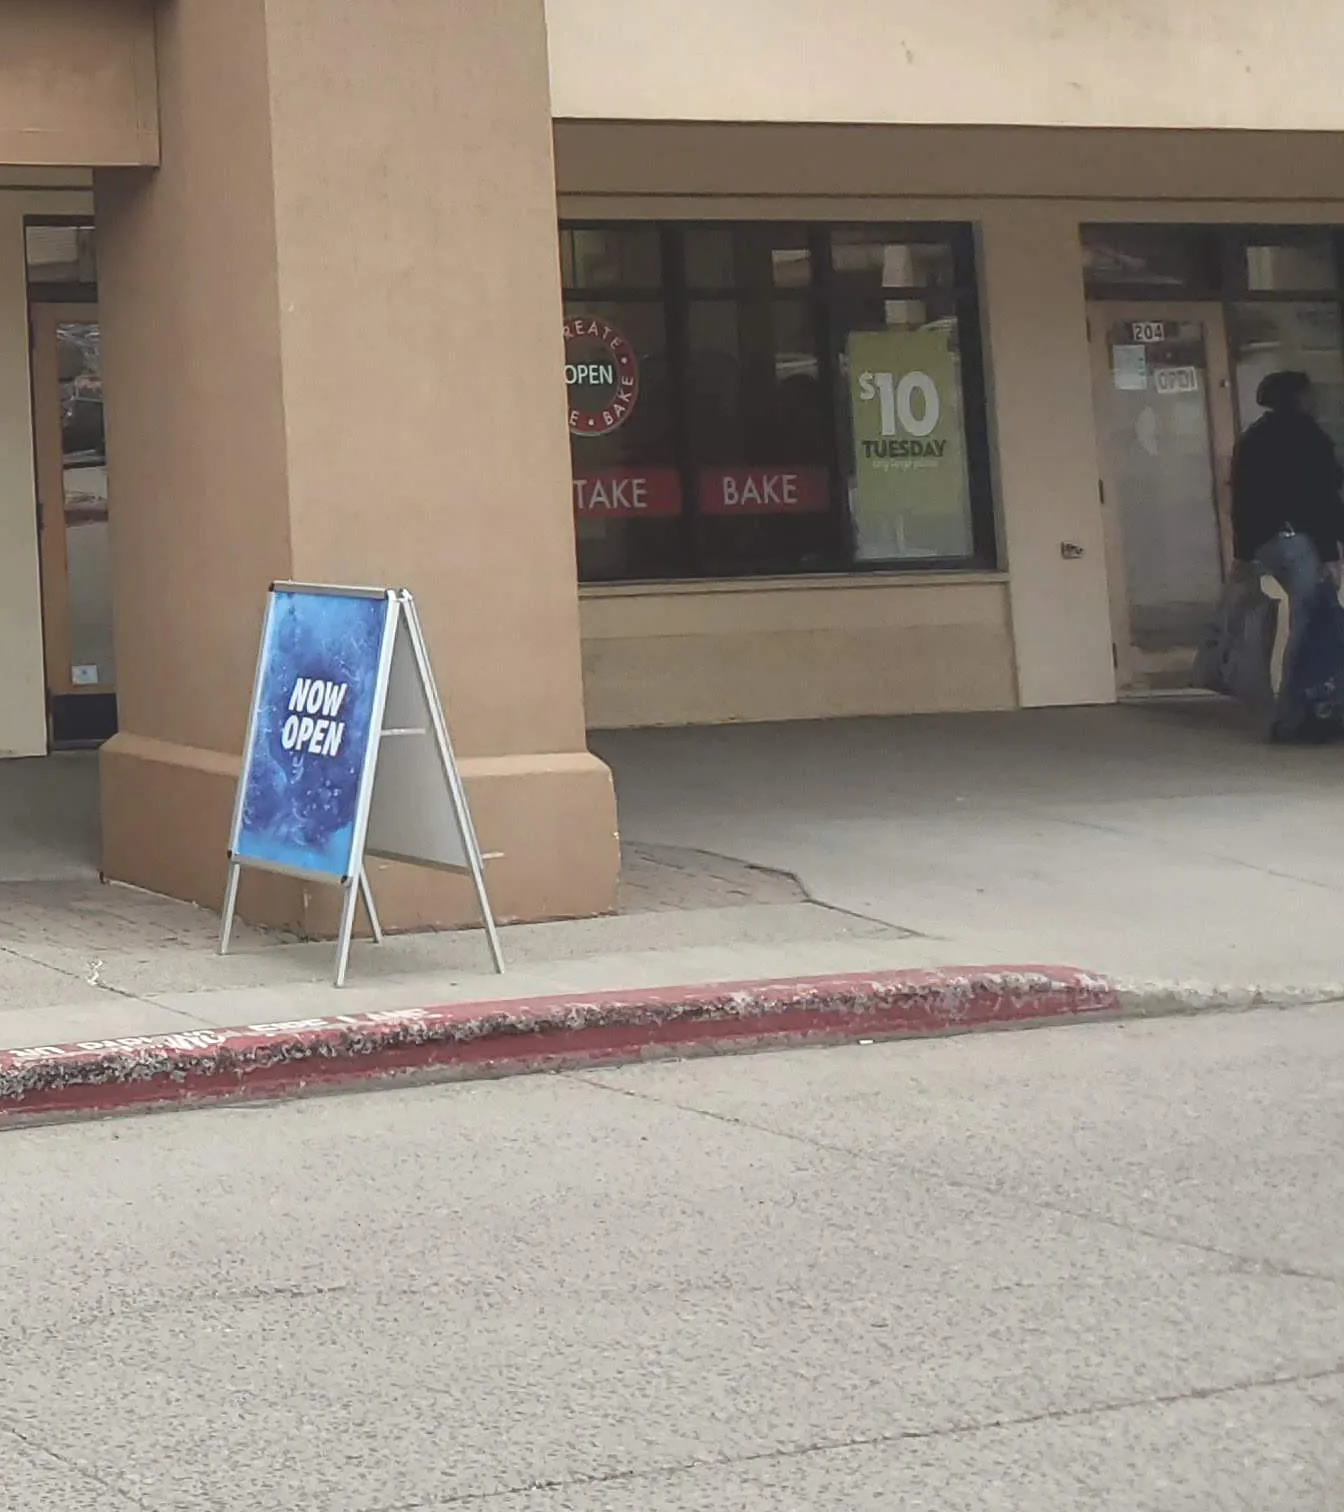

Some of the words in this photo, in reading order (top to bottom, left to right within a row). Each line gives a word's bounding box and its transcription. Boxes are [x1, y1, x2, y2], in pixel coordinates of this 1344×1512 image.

[563, 319, 622, 350] REATE
[1135, 324, 1163, 340] 204
[564, 364, 613, 385] OPEN
[602, 375, 634, 426] BAKE
[858, 370, 940, 437] $10
[861, 439, 947, 458] TUESDAY
[573, 478, 648, 509] TAKE
[723, 474, 798, 506] BAKE
[288, 677, 348, 717] NOW
[282, 715, 345, 757] OPEN
